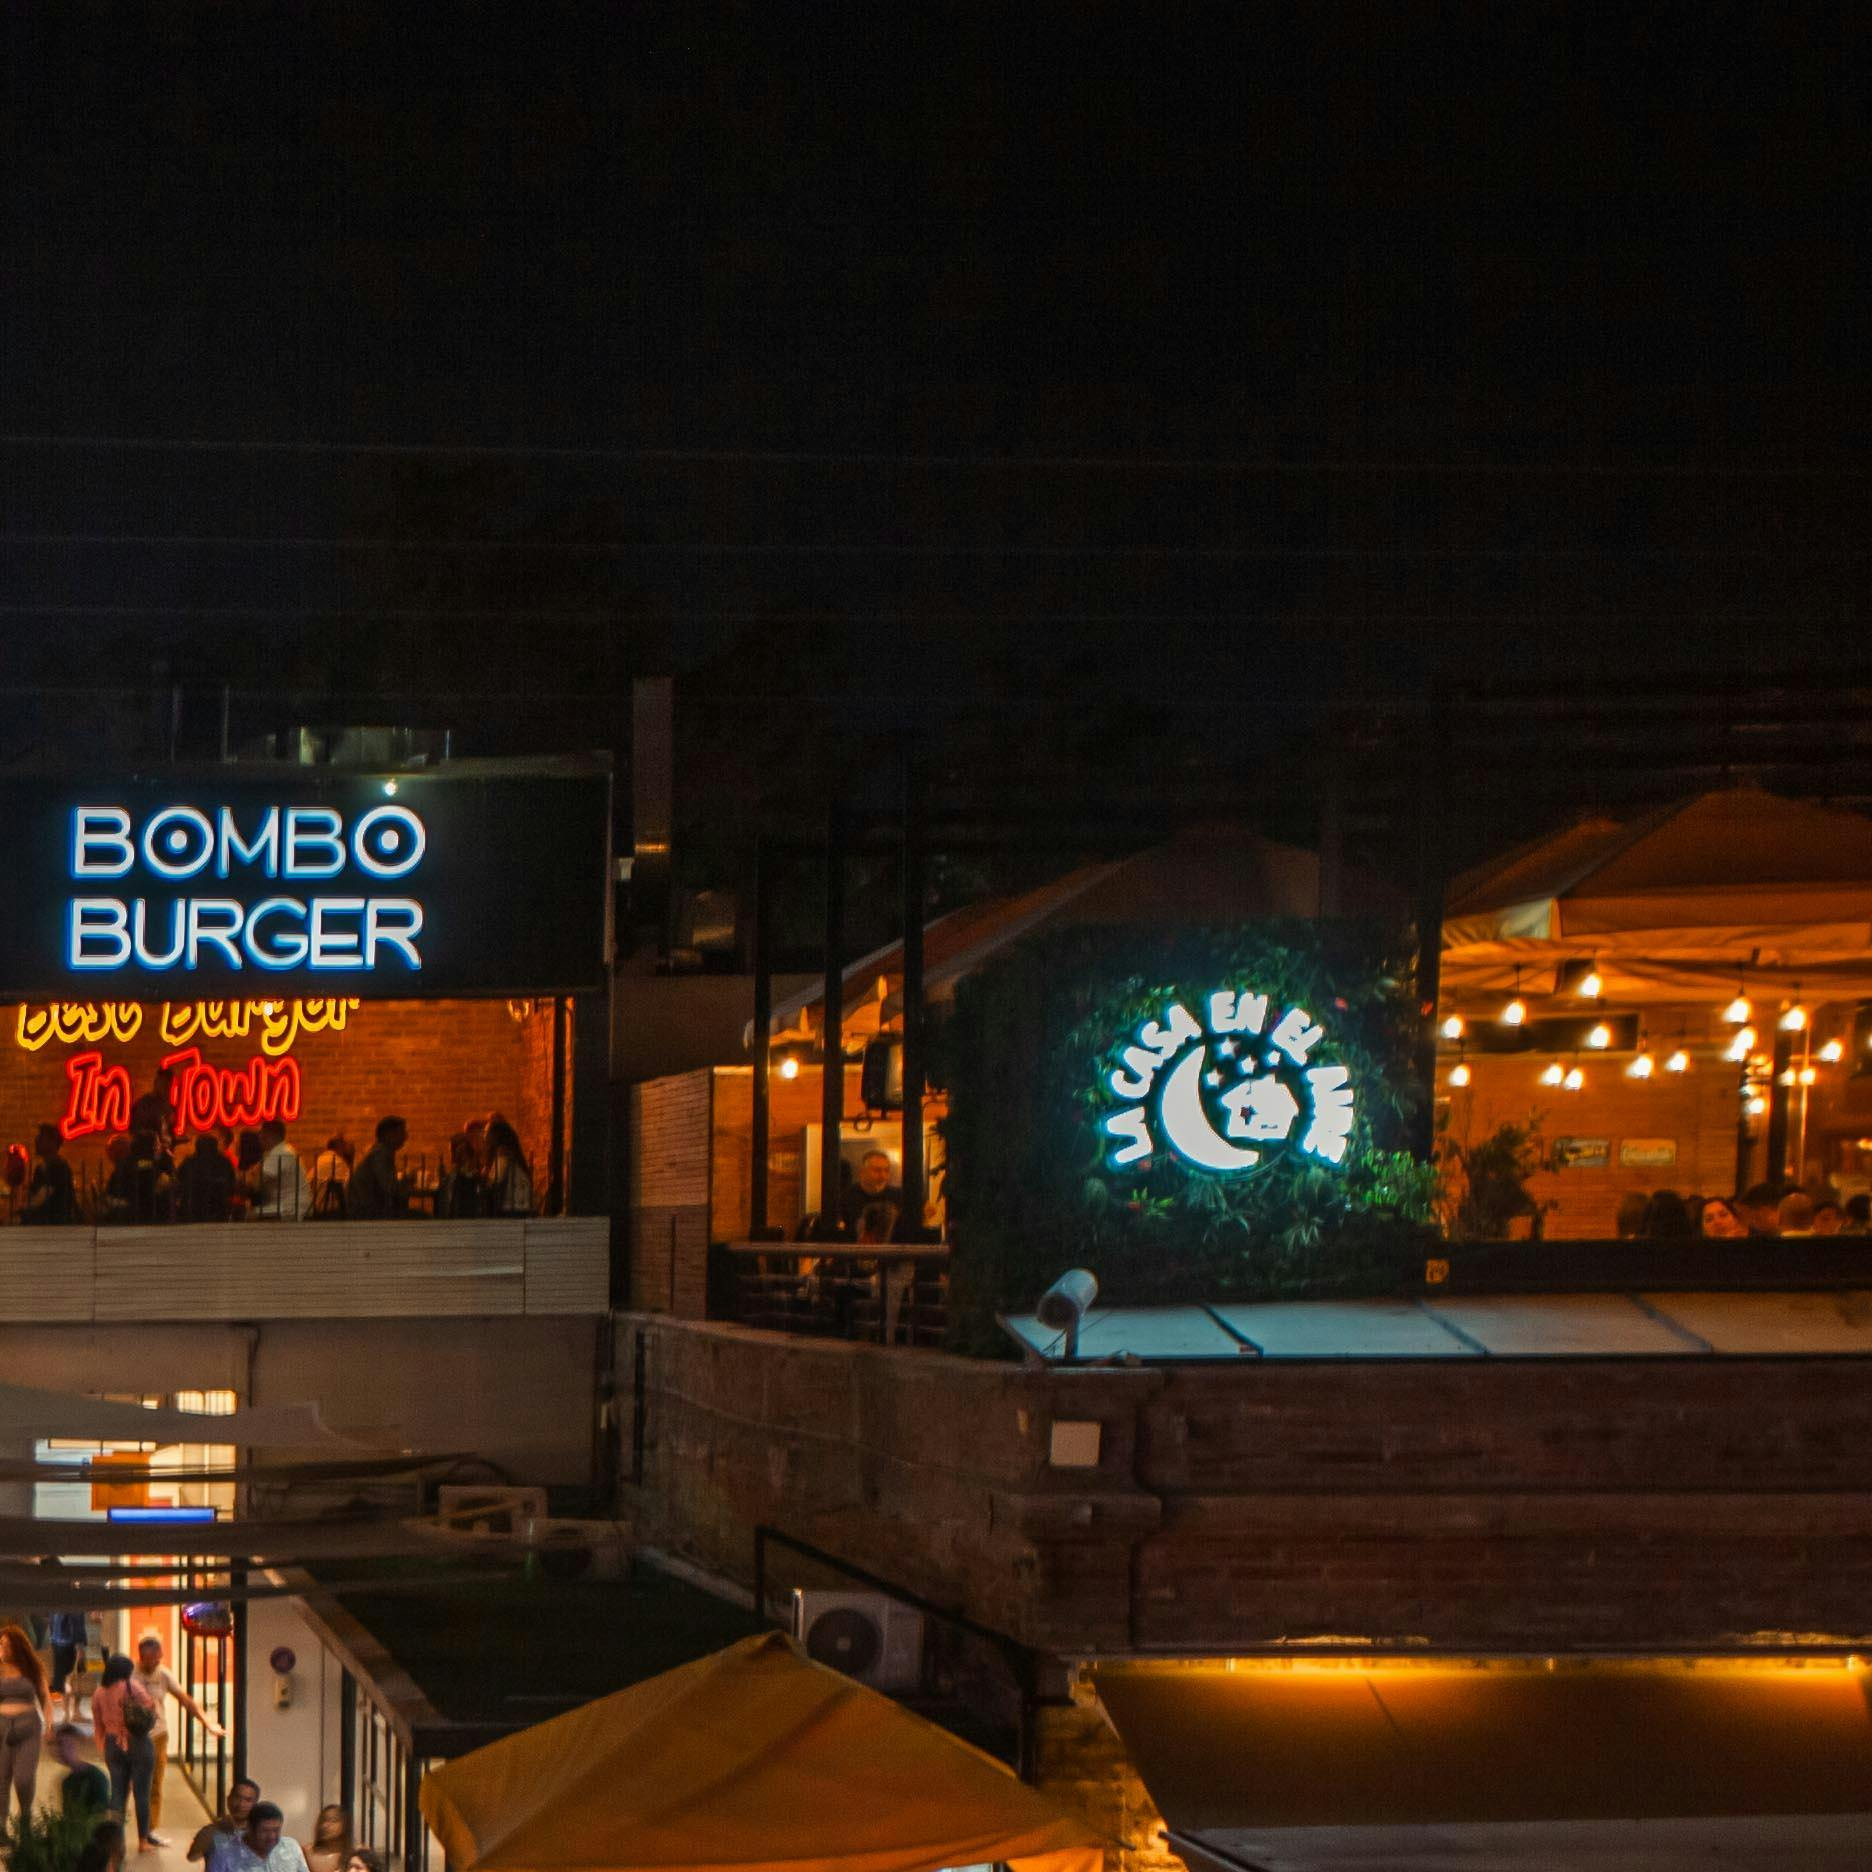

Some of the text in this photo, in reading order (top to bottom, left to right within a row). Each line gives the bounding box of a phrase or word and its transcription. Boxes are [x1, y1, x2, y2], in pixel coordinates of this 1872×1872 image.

[70, 805, 427, 879] BOMBO
[68, 896, 424, 971] BURGER
[1111, 1003, 1204, 1100] CASA
[1210, 990, 1269, 1035] EN
[1271, 1007, 1324, 1066] EL
[60, 1047, 301, 1140] In Town
